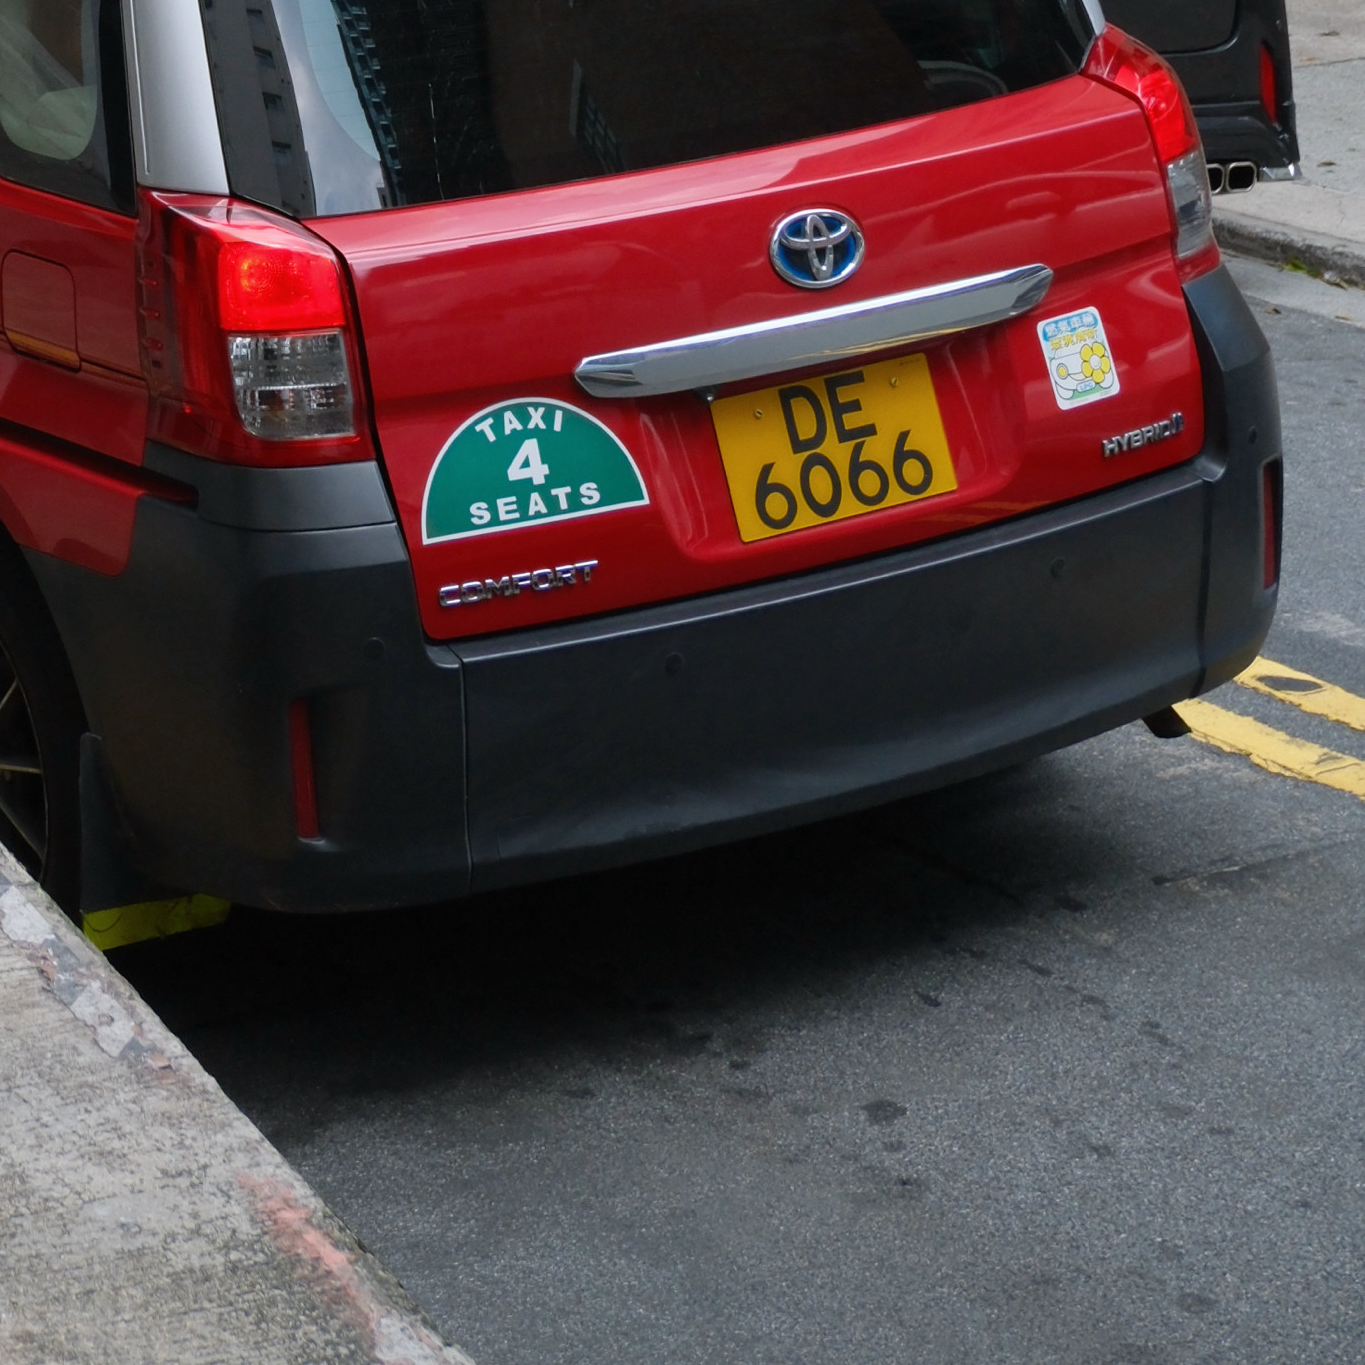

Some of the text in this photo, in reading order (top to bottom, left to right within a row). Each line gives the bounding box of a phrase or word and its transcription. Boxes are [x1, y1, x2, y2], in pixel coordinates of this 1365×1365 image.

[474, 406, 564, 443] TAXI
[778, 370, 878, 456] DE
[506, 437, 550, 486] 4
[1101, 419, 1172, 459] HYBRID
[755, 429, 934, 530] 6066
[469, 482, 602, 526] SEATS
[439, 559, 599, 607] COMFORT
